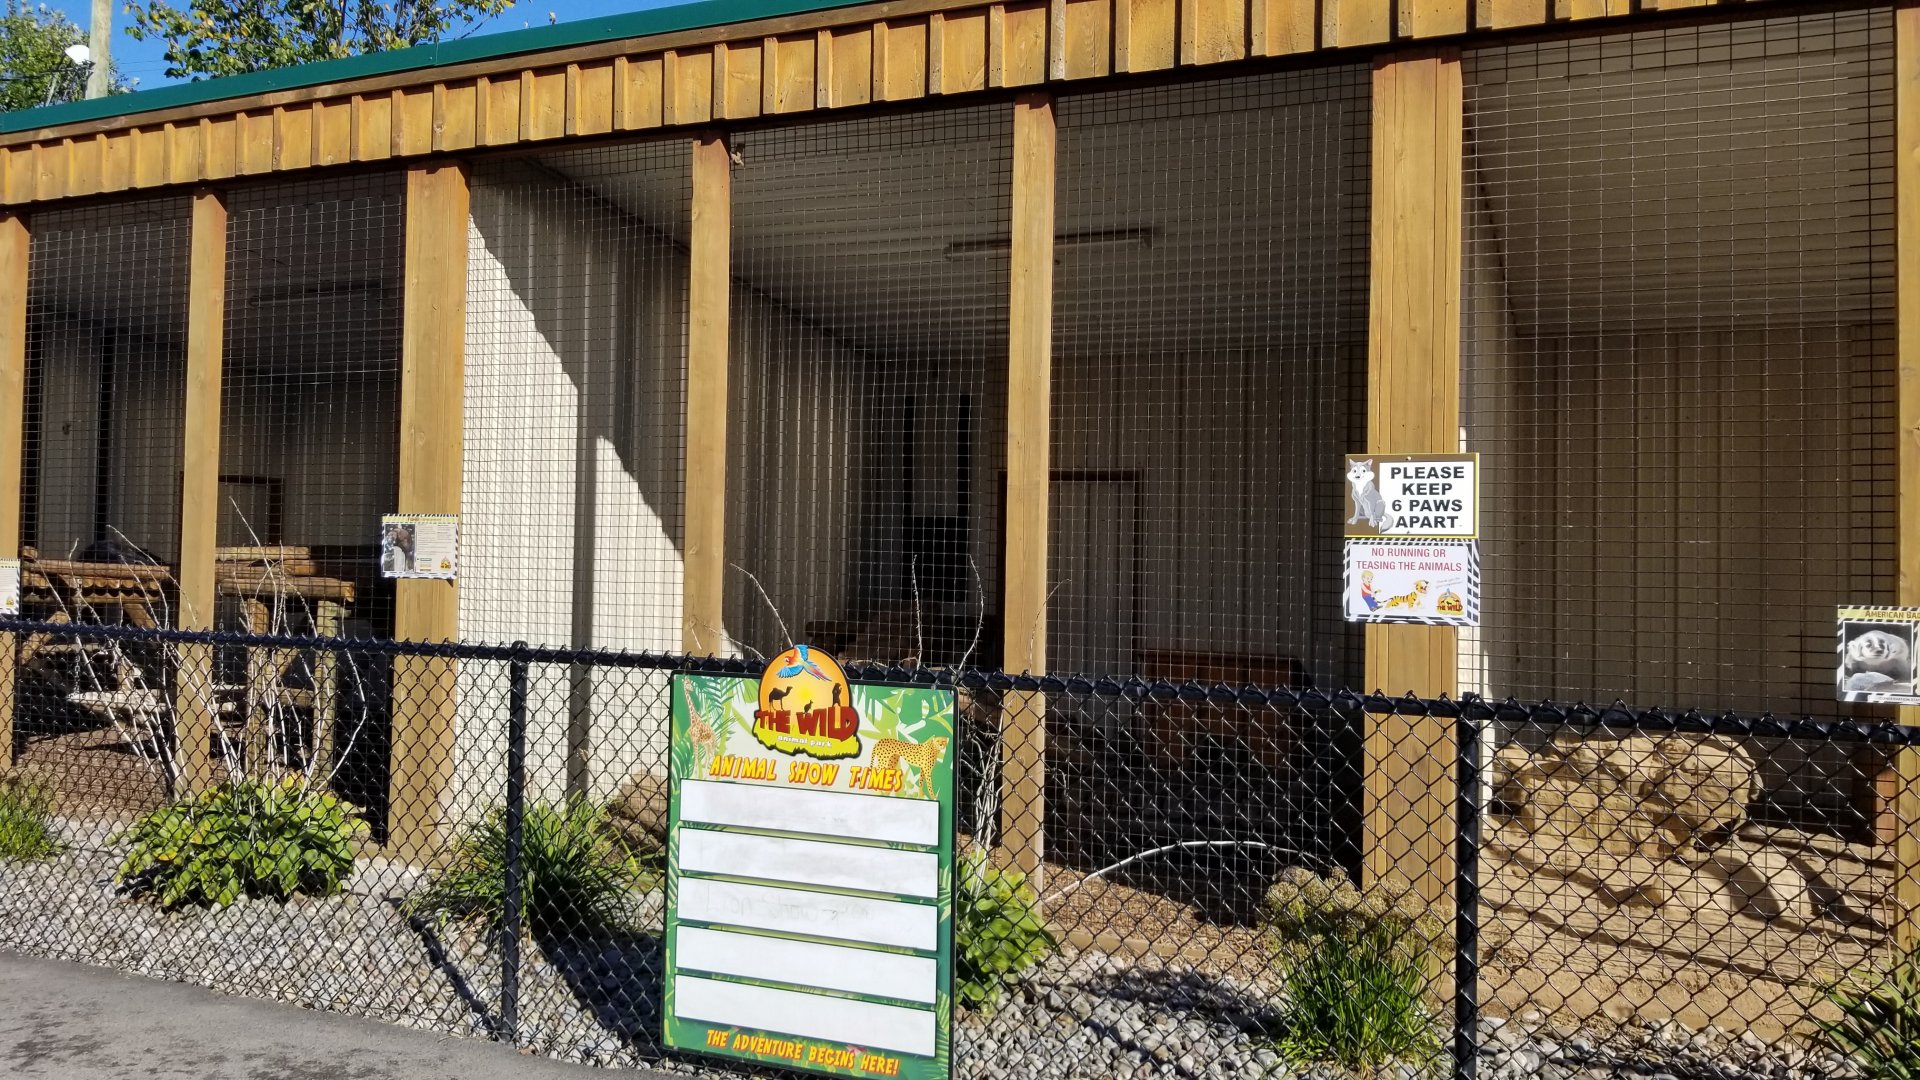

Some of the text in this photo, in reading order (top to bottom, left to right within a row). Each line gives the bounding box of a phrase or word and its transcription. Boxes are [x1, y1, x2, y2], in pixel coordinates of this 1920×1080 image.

[1390, 466, 1464, 479] PLEASE
[1402, 483, 1453, 495] KEEP
[1391, 500, 1462, 512] 6 PAWS
[1395, 516, 1459, 528] APART
[1371, 548, 1446, 557] NO RUNNING OR
[1356, 561, 1462, 571] TEASING THE ANIMALS
[1865, 610, 1904, 619] AMERICAN
[755, 706, 858, 742] THE WILD
[778, 735, 807, 744] animal
[709, 755, 904, 792] ANIMAL SHOW TIMES
[706, 1029, 900, 1076] THE ADVENTURE BEGINS HERE!
